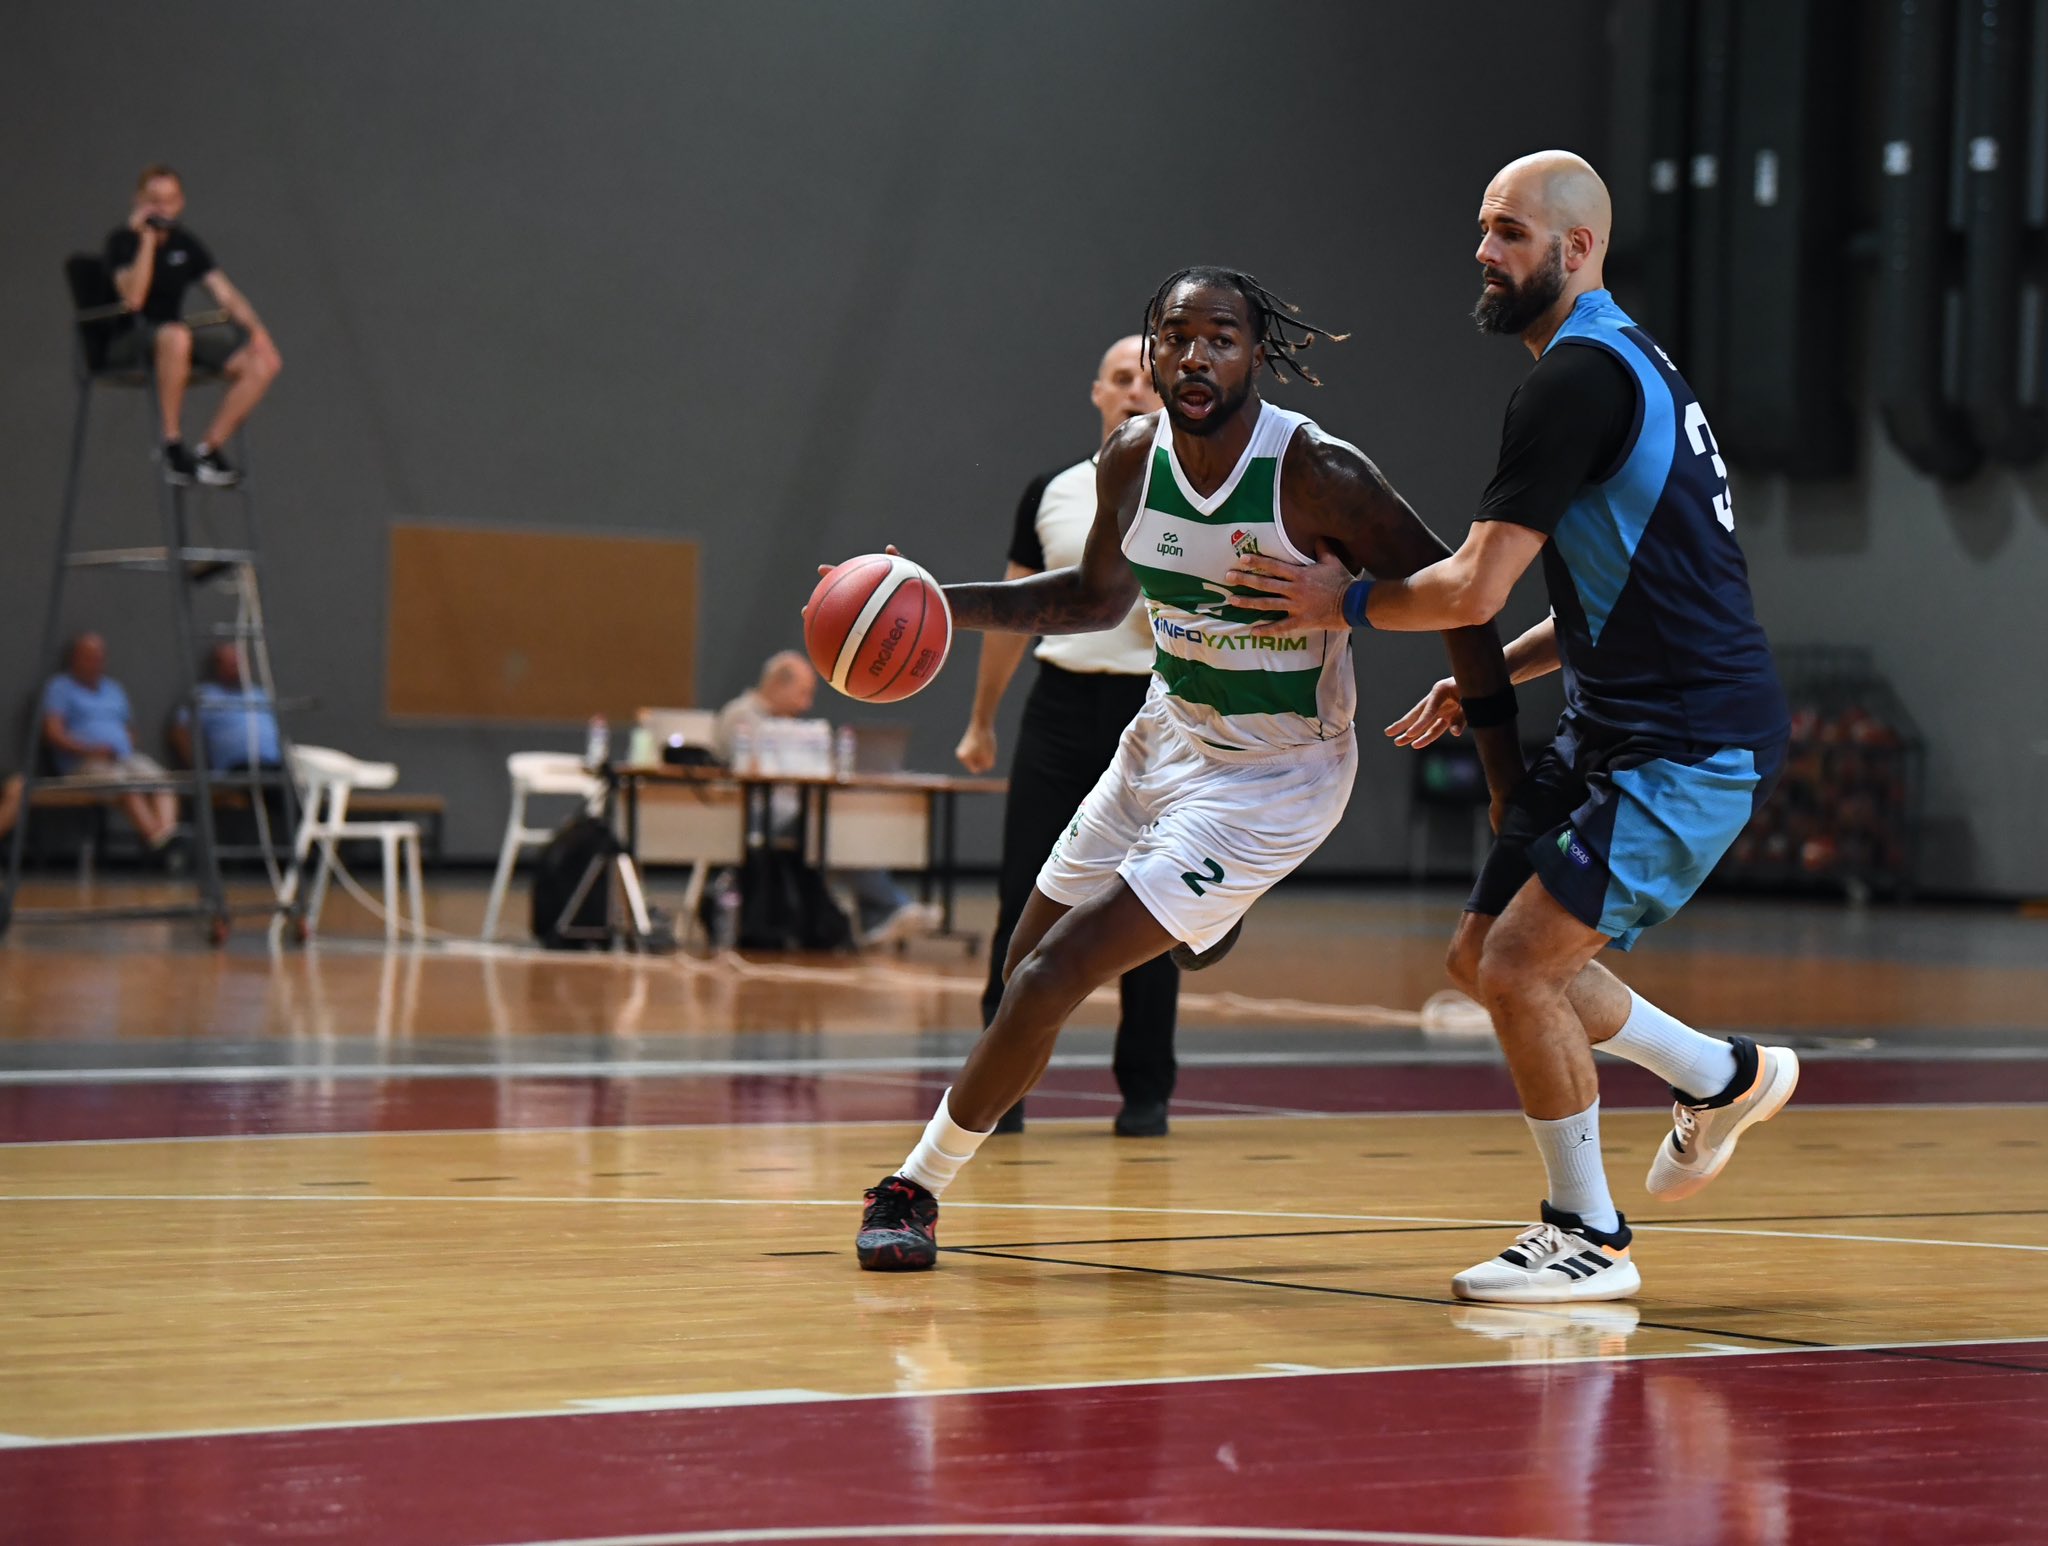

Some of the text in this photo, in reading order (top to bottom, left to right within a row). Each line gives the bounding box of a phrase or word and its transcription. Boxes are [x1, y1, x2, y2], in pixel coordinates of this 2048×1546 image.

[1157, 543, 1183, 557] upon
[868, 617, 908, 676] molten
[1181, 857, 1225, 897] 2
